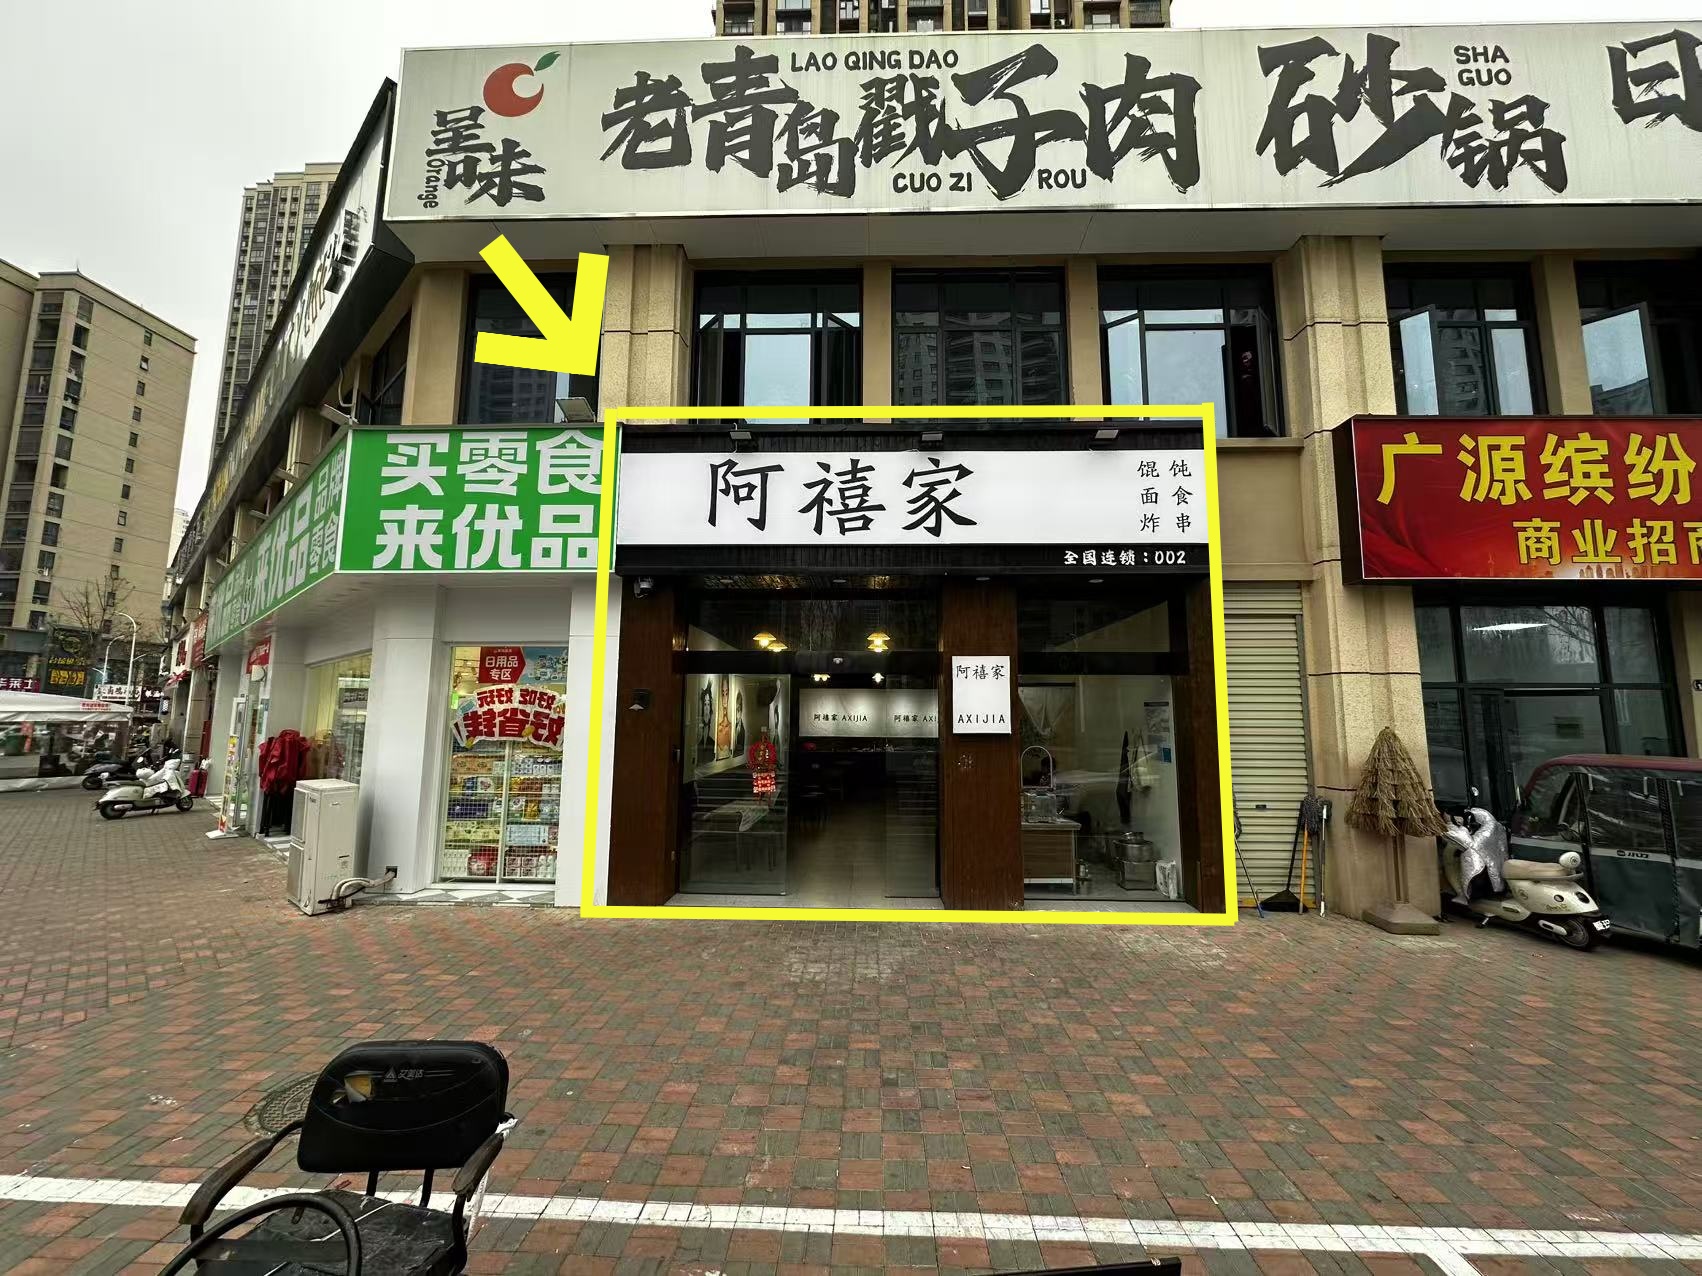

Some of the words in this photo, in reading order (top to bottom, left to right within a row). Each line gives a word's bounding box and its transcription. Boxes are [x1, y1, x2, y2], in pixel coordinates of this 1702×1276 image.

[791, 50, 837, 72] LAO
[844, 49, 900, 71] QING
[908, 48, 959, 70] DAO
[1455, 44, 1510, 65] SHA
[1457, 67, 1512, 87] GUO
[1257, 33, 1567, 193] 砂锅
[417, 158, 446, 209] Orange
[893, 173, 940, 193] CUO
[945, 172, 972, 192] ZI
[1037, 170, 1087, 189] ROU
[380, 431, 603, 497] 买零食
[1137, 459, 1192, 478] 馄饨
[1377, 432, 1697, 506] 广源缤纷
[707, 458, 979, 537] 阿禧家
[1140, 485, 1193, 506] 面食
[1139, 512, 1192, 534] 炸串
[372, 504, 600, 569] 来优品
[485, 656, 519, 668] 日用品
[956, 664, 1006, 680] 阿禧家
[490, 668, 511, 680] 专区
[957, 713, 1006, 724] AXIJIA
